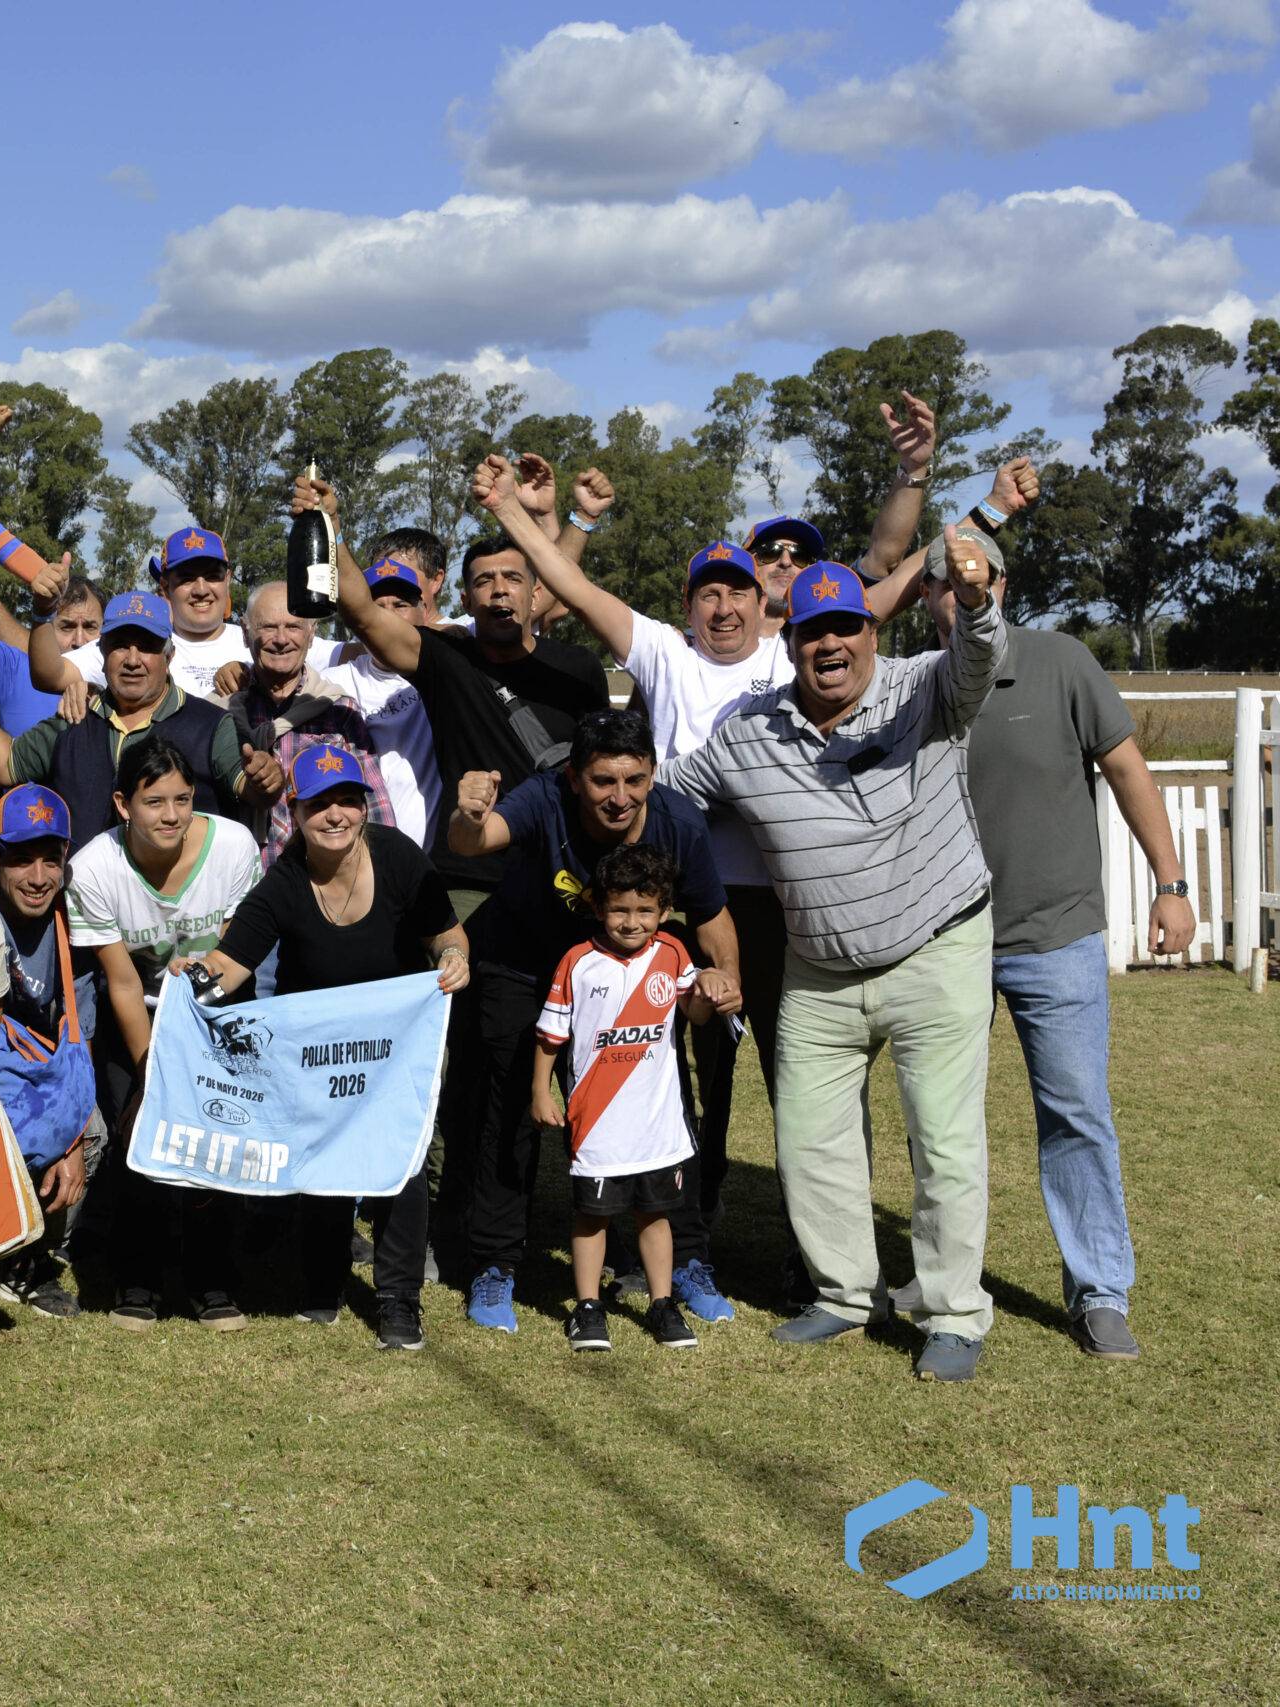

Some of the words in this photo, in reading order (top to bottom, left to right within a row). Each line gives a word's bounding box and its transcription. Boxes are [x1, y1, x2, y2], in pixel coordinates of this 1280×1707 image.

[328, 542, 337, 602] CHANDON
[595, 1024, 663, 1049] BRADAS
[301, 1044, 329, 1068] POLLA
[332, 1043, 344, 1065] DE
[346, 1039, 393, 1064] POTRILLOS
[611, 1049, 655, 1063] SEGURA
[205, 1077, 216, 1090] DE
[217, 1082, 238, 1097] MAYO
[240, 1088, 265, 1103] 2026
[329, 1073, 366, 1099] 2026
[151, 1120, 205, 1168] LET
[206, 1131, 240, 1177] IT
[240, 1140, 289, 1184] RIP
[594, 1177, 605, 1199] 7
